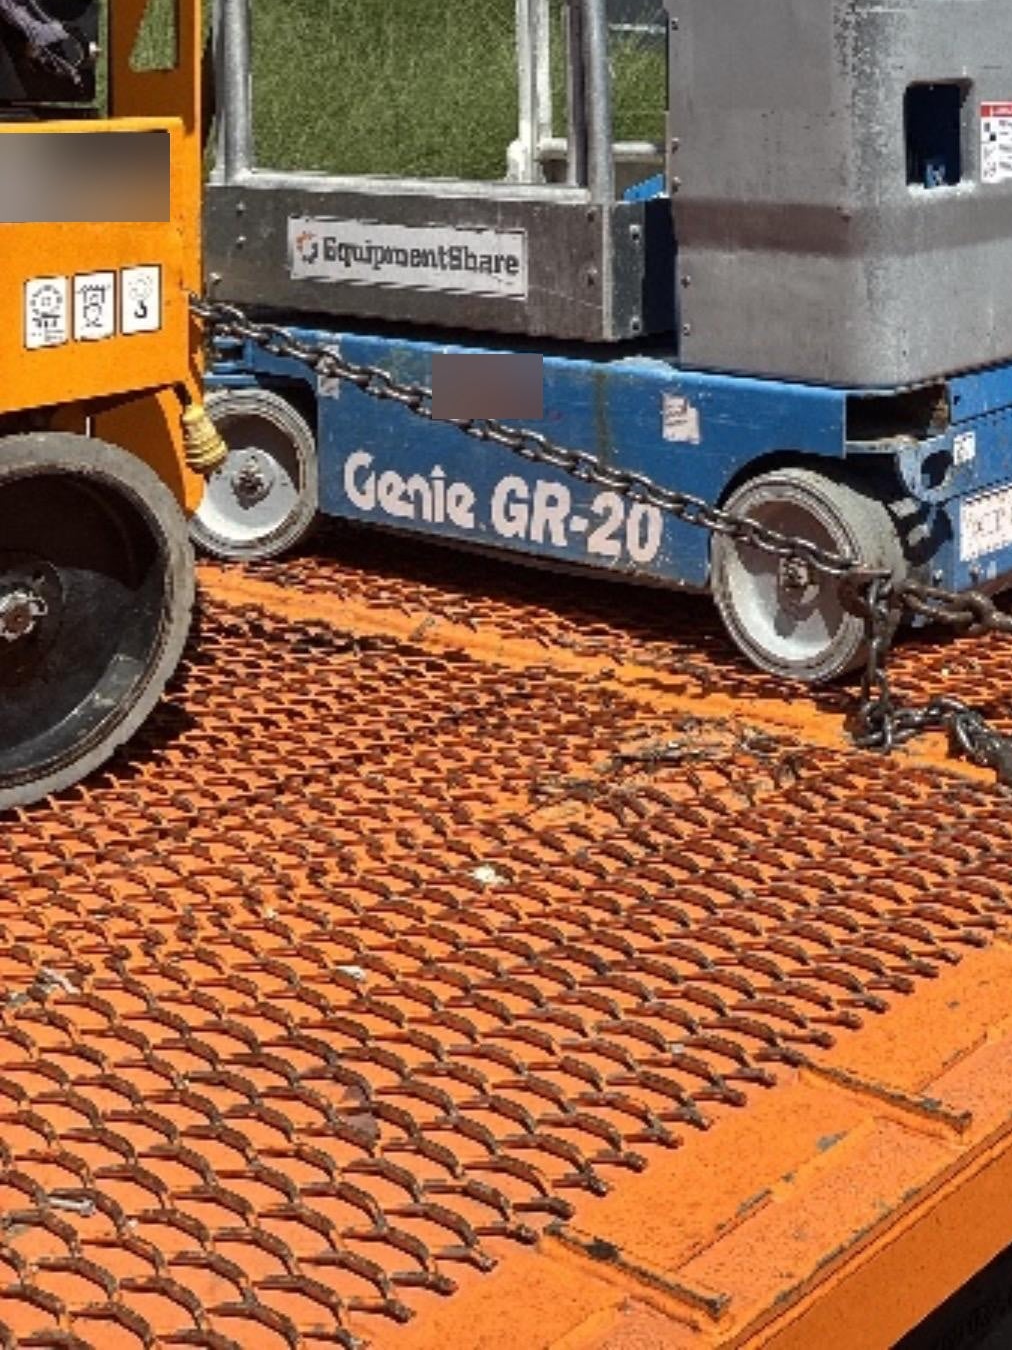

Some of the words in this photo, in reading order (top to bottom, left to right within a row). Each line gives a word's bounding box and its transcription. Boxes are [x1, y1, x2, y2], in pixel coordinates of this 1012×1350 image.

[323, 235, 521, 275] EquipmentShare
[343, 449, 478, 530] Genie
[490, 474, 664, 563] GR-20
